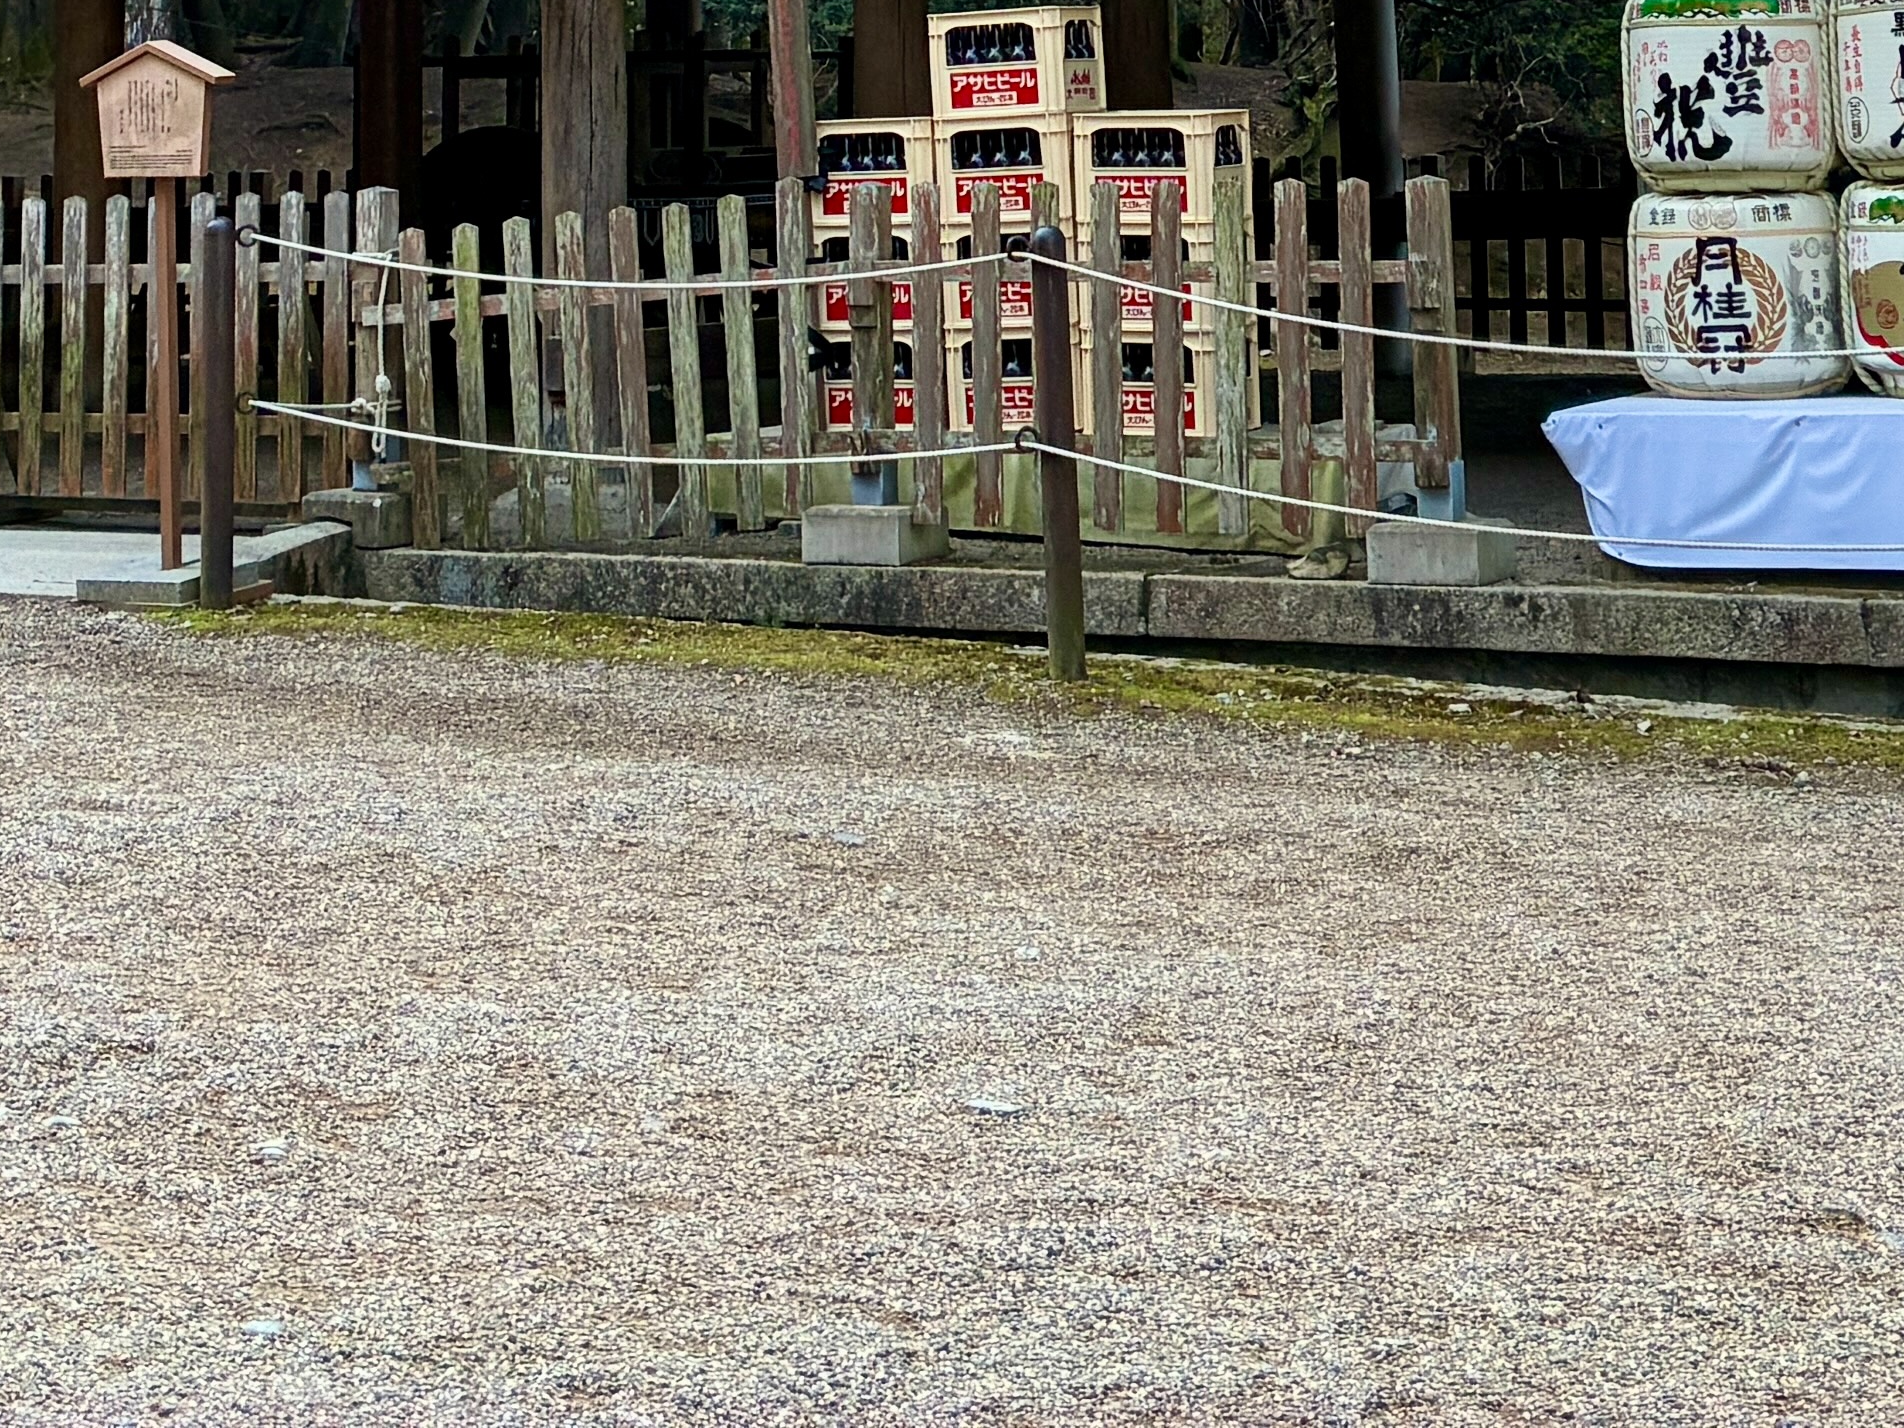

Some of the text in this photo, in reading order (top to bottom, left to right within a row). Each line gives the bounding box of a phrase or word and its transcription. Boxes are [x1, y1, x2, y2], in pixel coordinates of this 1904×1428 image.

[952, 71, 1036, 93] アサヒビール
[1691, 235, 1753, 376] 月桂冠
